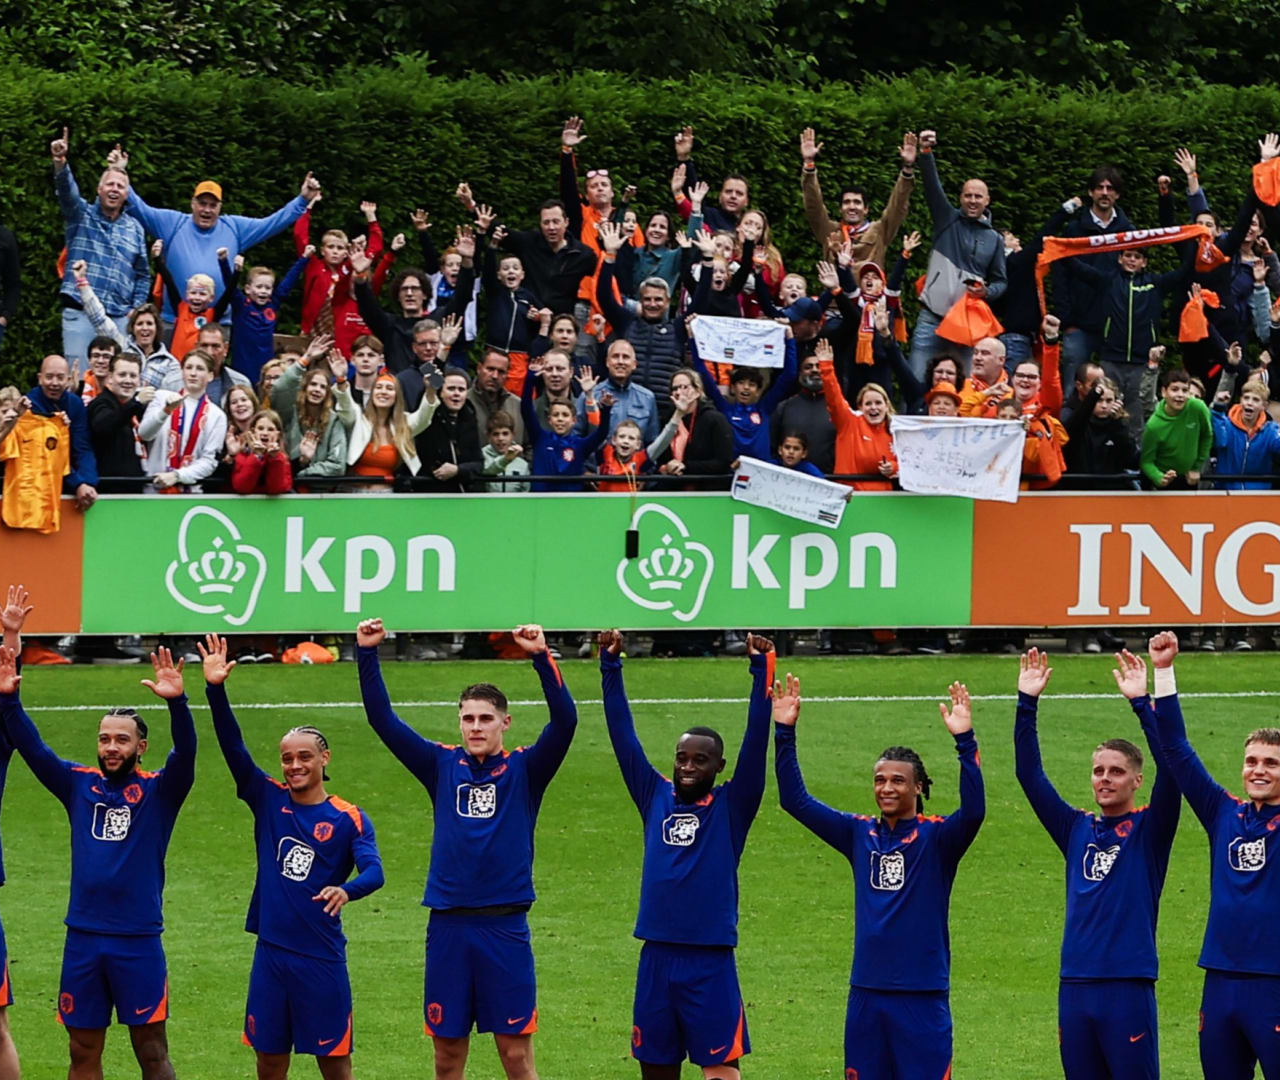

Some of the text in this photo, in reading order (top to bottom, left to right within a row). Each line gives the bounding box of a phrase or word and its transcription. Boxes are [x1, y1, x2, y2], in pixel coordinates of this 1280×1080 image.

[1089, 225, 1182, 247] DE JONG
[284, 516, 457, 613] kpn
[731, 514, 897, 610] kpn
